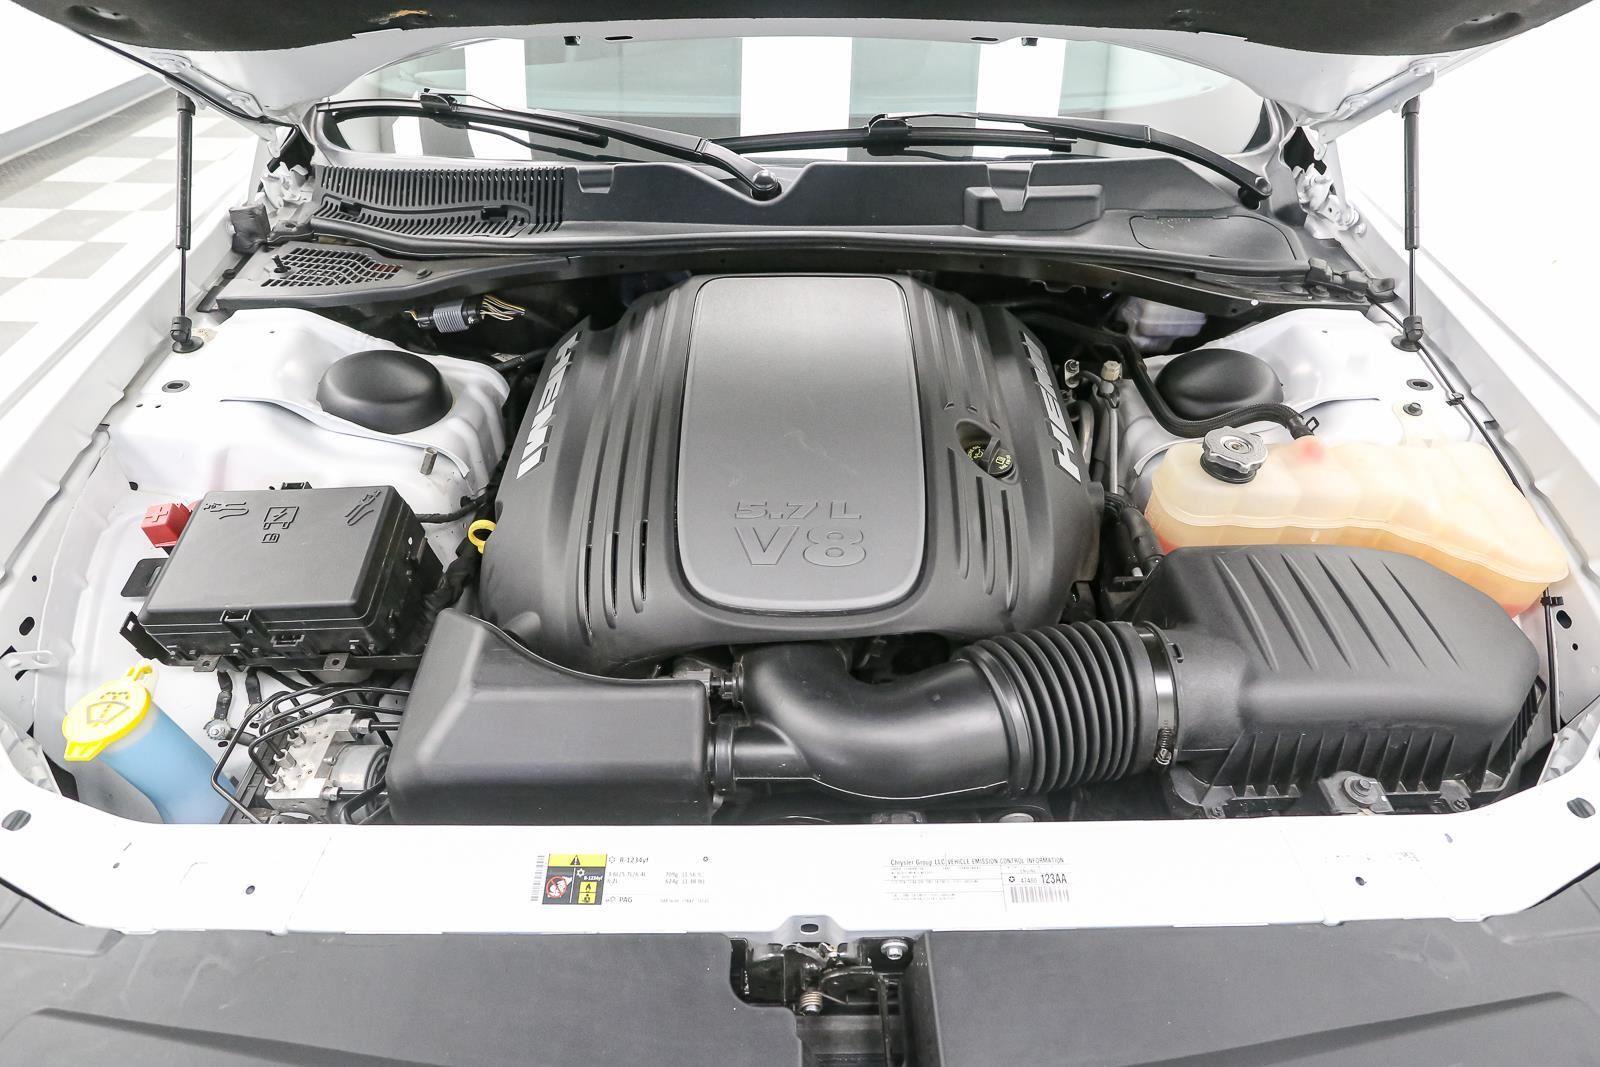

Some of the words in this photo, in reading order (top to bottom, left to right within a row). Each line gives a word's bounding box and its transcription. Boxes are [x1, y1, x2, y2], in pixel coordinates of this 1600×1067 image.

[516, 331, 579, 480] HEMI
[1022, 332, 1082, 483] HEMI
[734, 524, 867, 567] V8
[972, 857, 998, 865] EMISSION
[1000, 857, 1025, 865] CONTROL
[1041, 873, 1067, 884] 123AA
